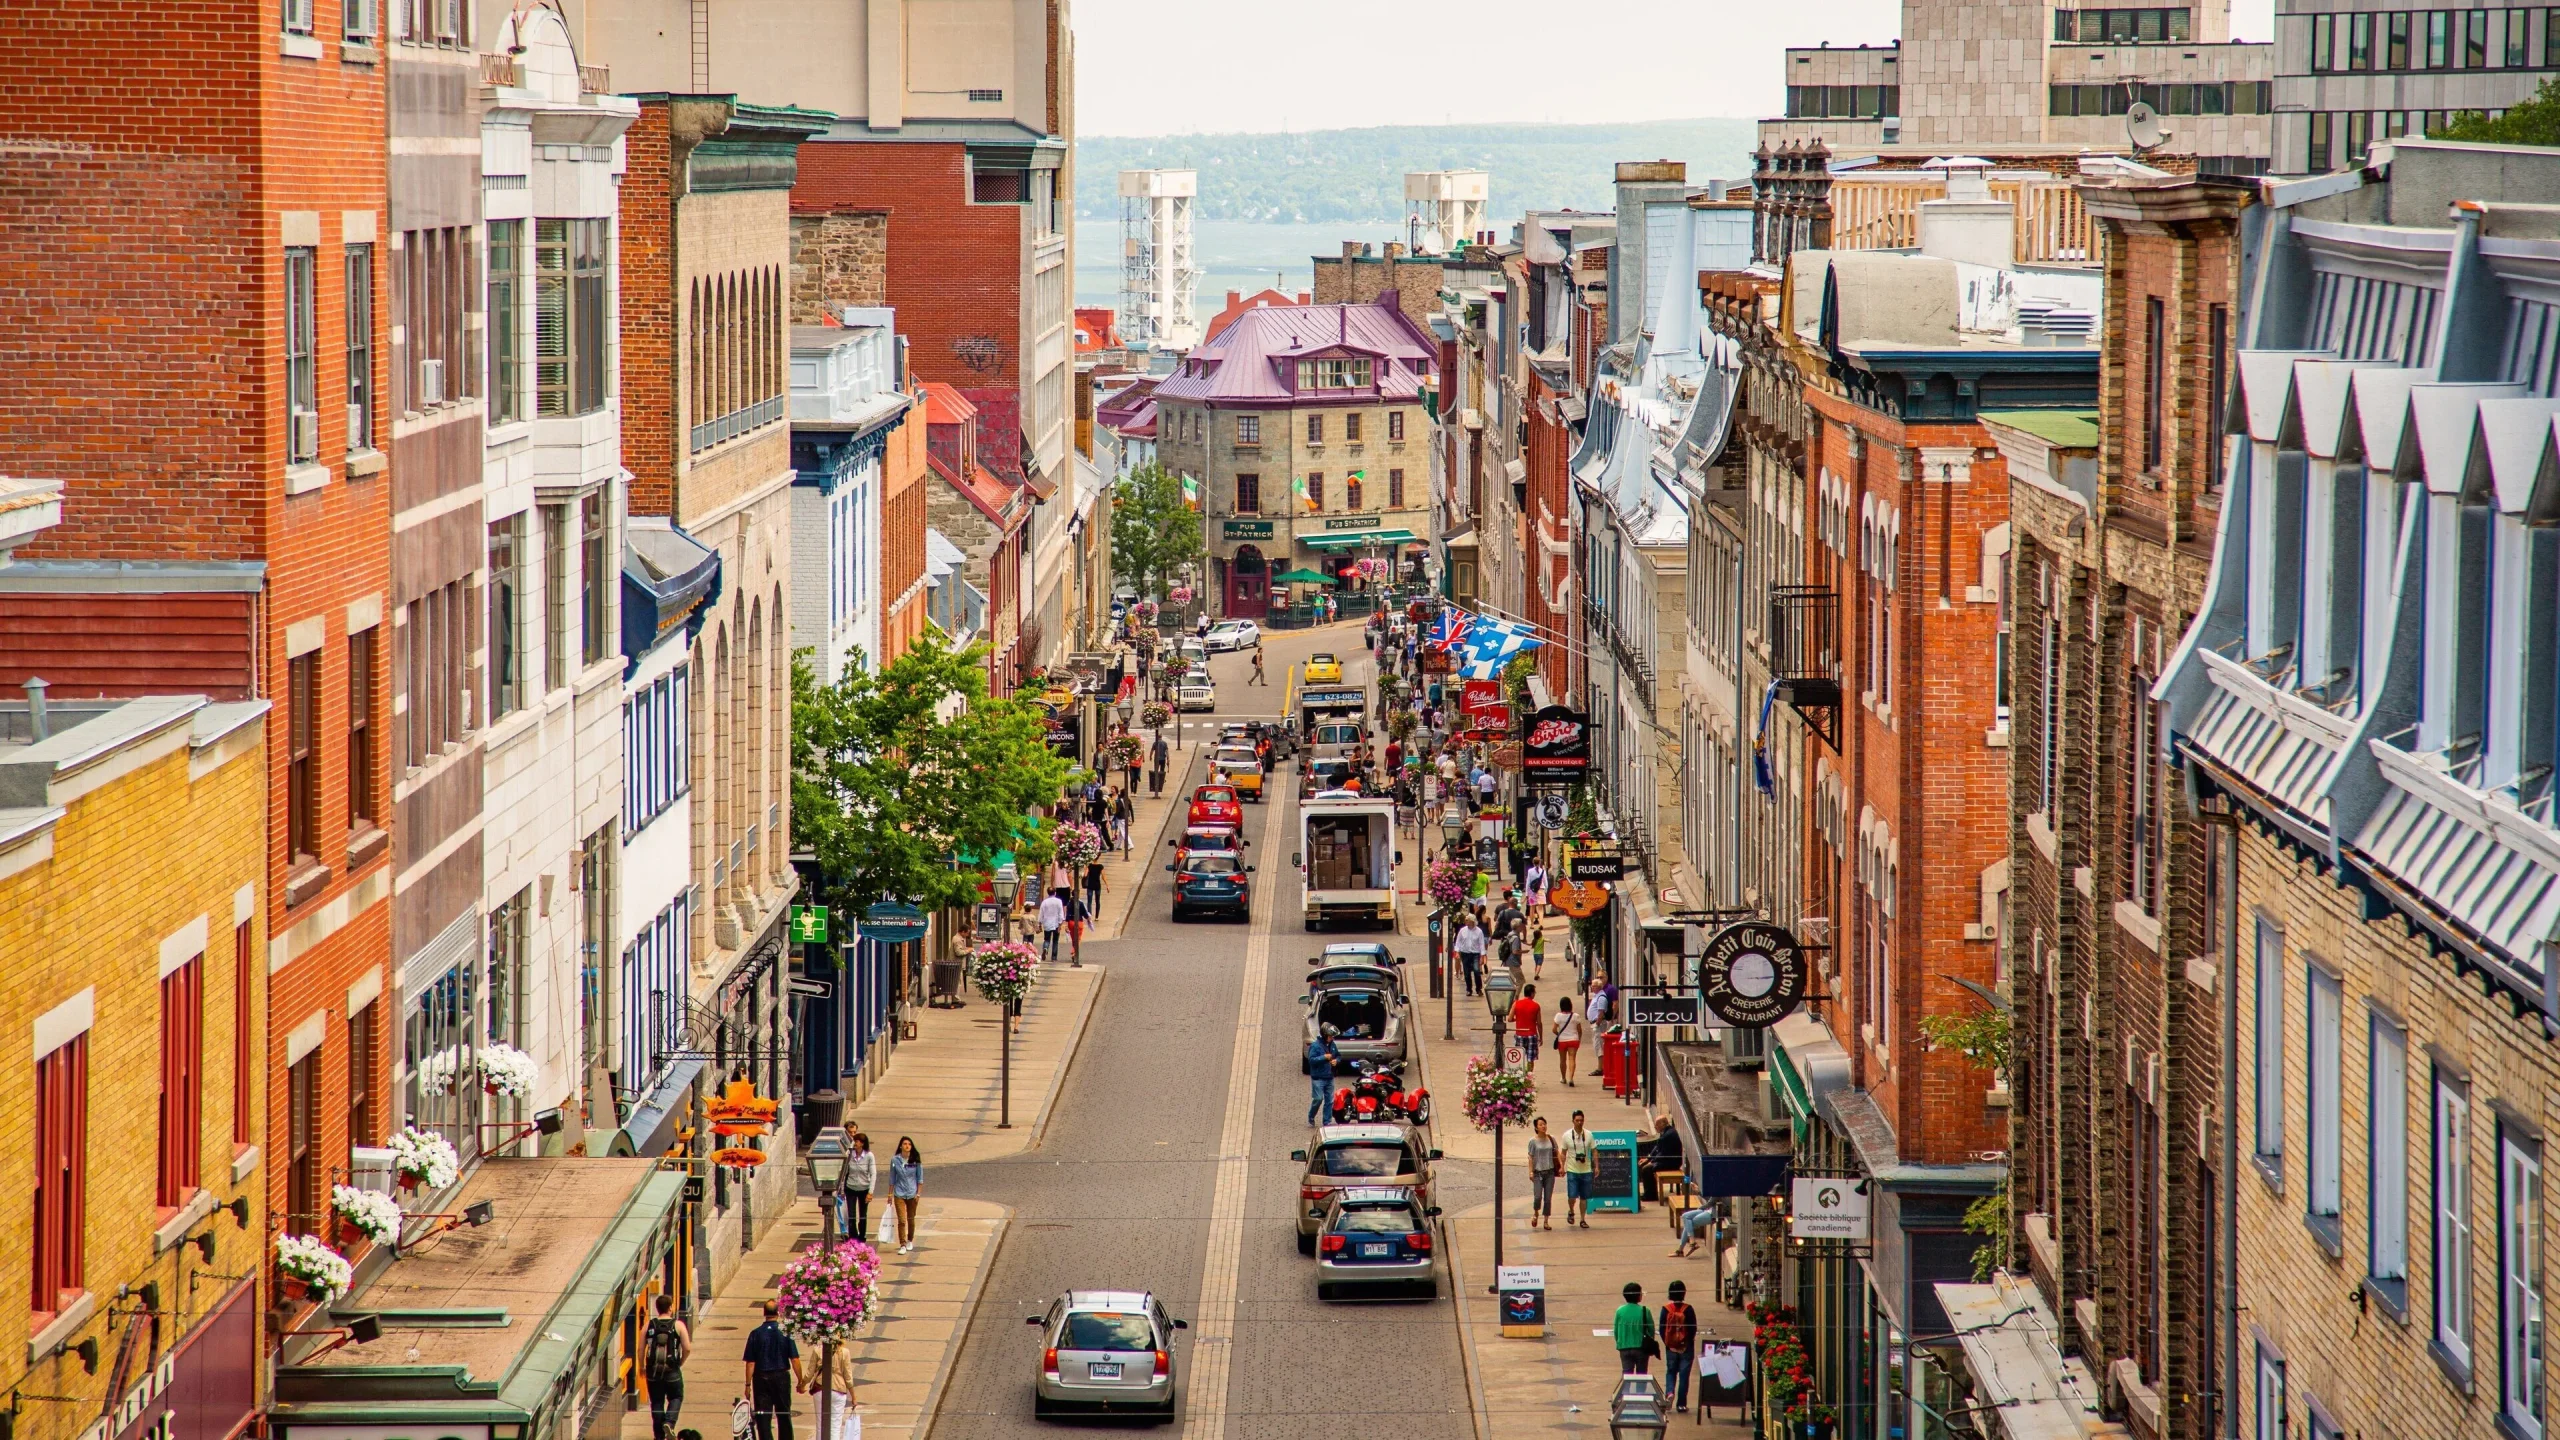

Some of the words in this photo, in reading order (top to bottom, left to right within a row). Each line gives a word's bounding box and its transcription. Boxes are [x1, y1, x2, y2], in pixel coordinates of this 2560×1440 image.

[2134, 112, 2146, 123] Bell
[1526, 722, 1576, 746] Bistro
[1577, 865, 1617, 874] RUDSAK
[1741, 928, 1777, 951] Coin
[1705, 935, 1739, 972] Petit
[1770, 947, 1799, 997] Breton
[1708, 973, 1732, 997] Au
[1634, 1000, 1693, 1023] bizou
[1723, 1004, 1783, 1022] RESTAURANT
[1798, 1212, 1828, 1221] Société
[1829, 1213, 1861, 1224] biblique
[1807, 1223, 1852, 1232] canadienne
